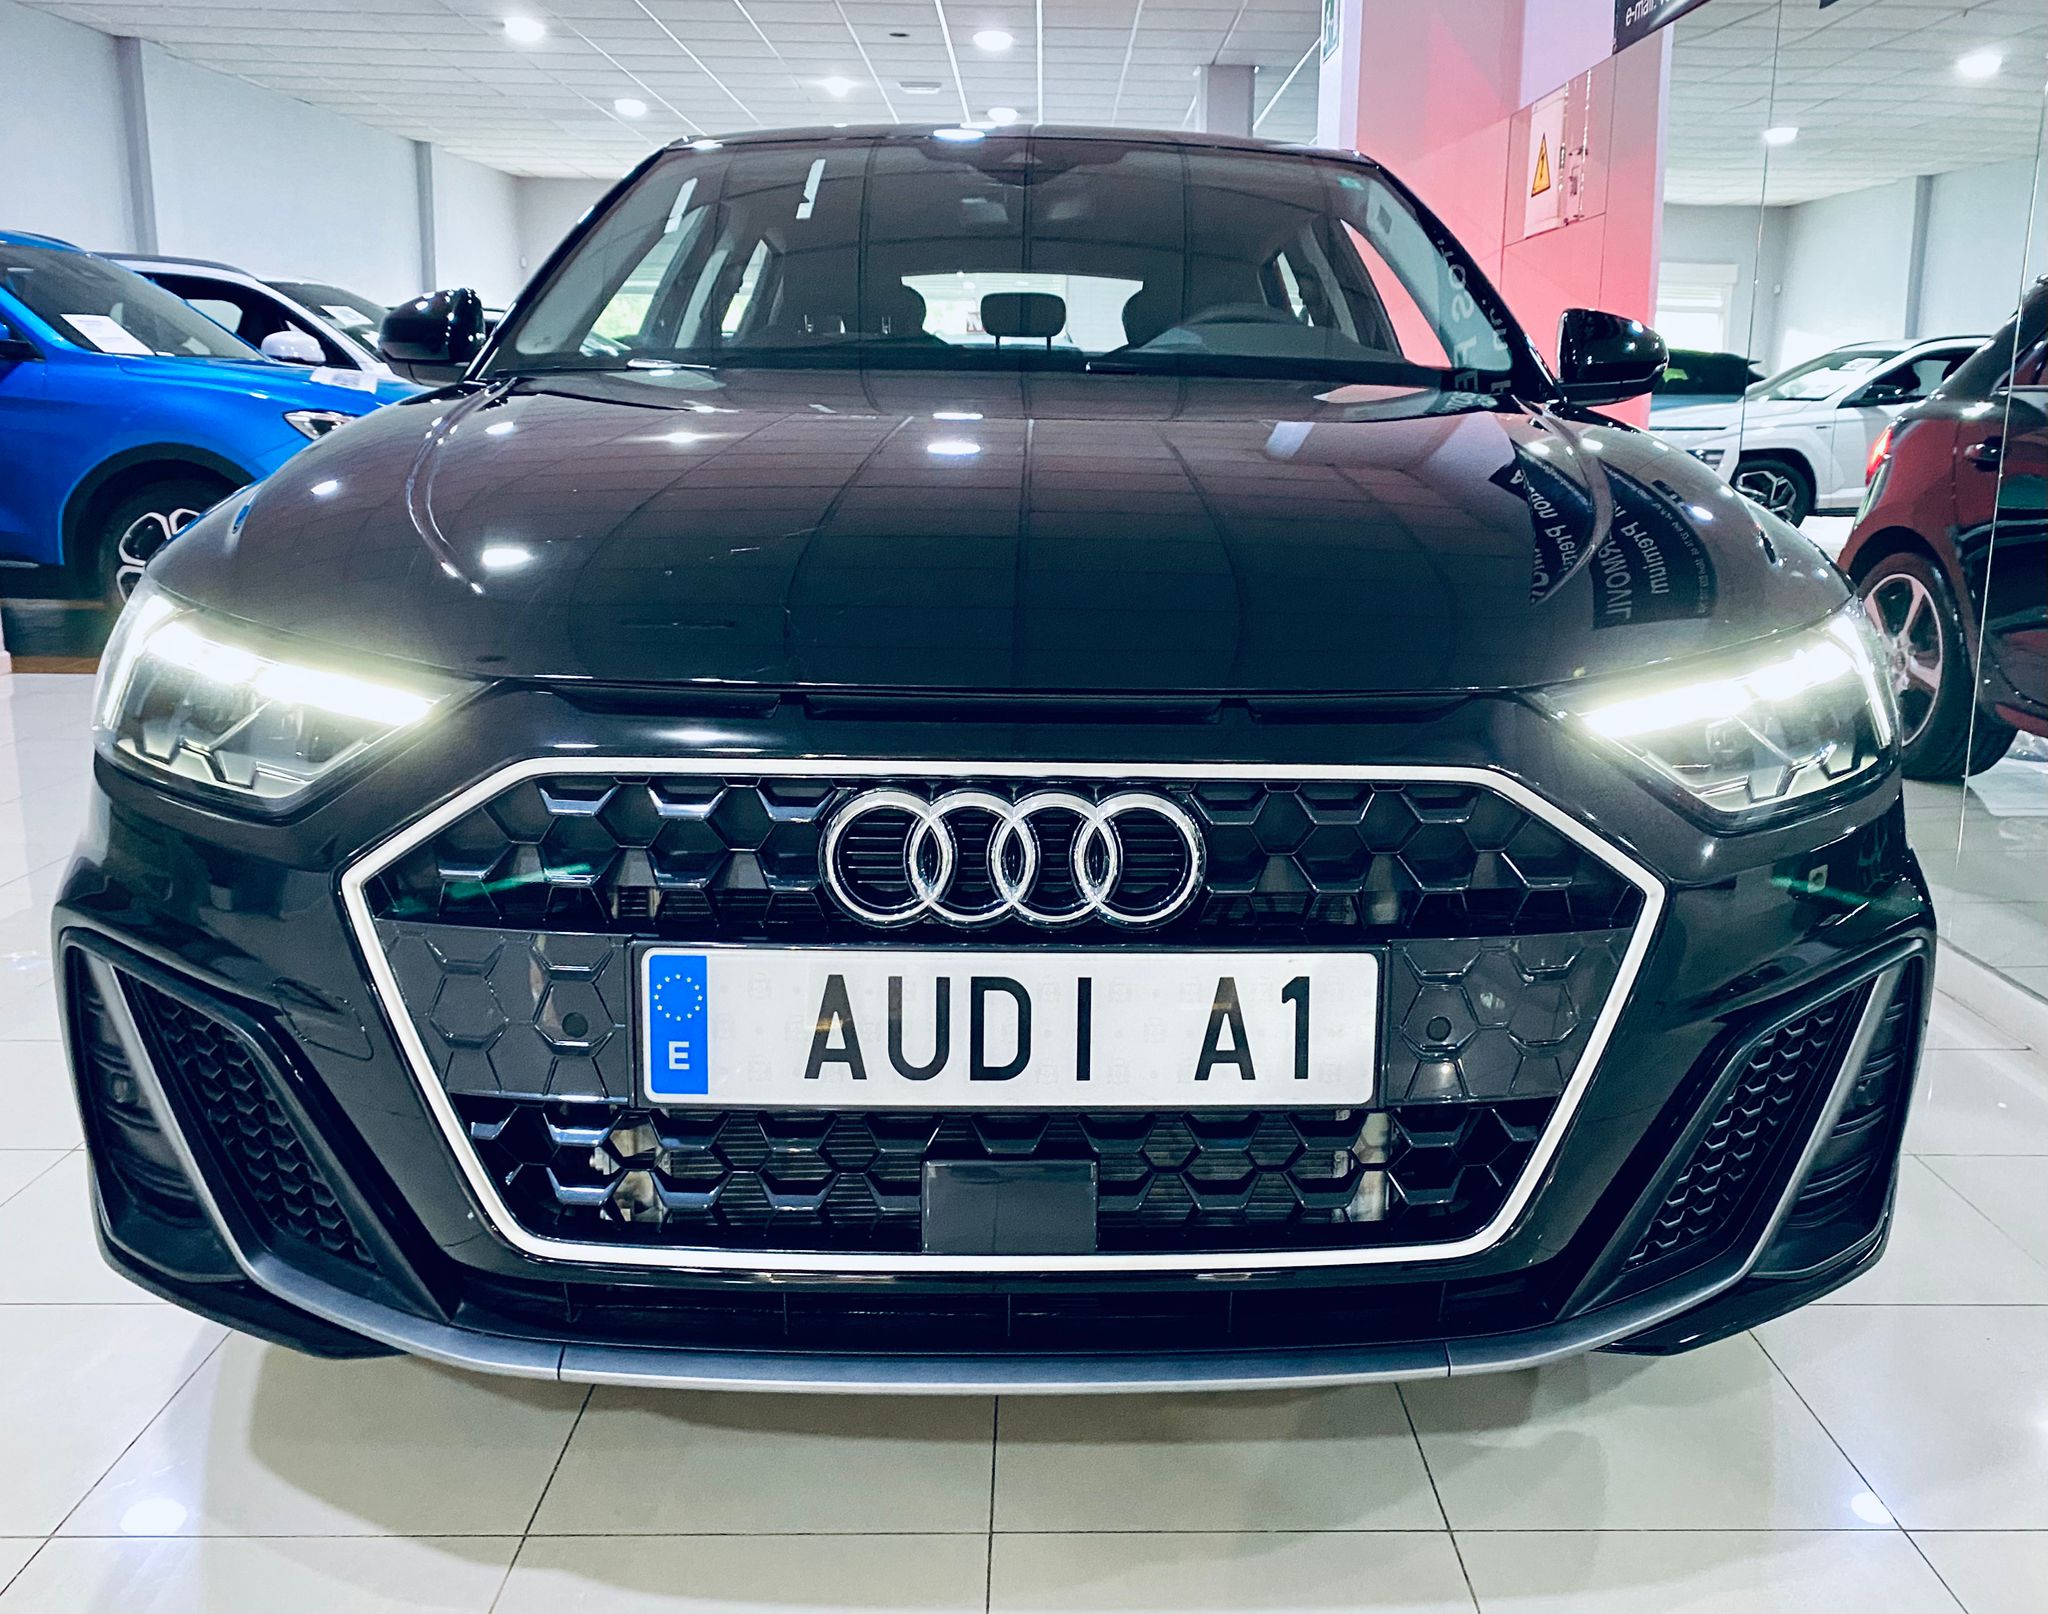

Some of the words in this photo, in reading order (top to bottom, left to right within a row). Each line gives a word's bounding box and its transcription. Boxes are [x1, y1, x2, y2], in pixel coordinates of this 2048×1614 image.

[669, 1042, 689, 1069] E
[805, 975, 1091, 1081] AUDI
[1195, 977, 1309, 1080] A1
